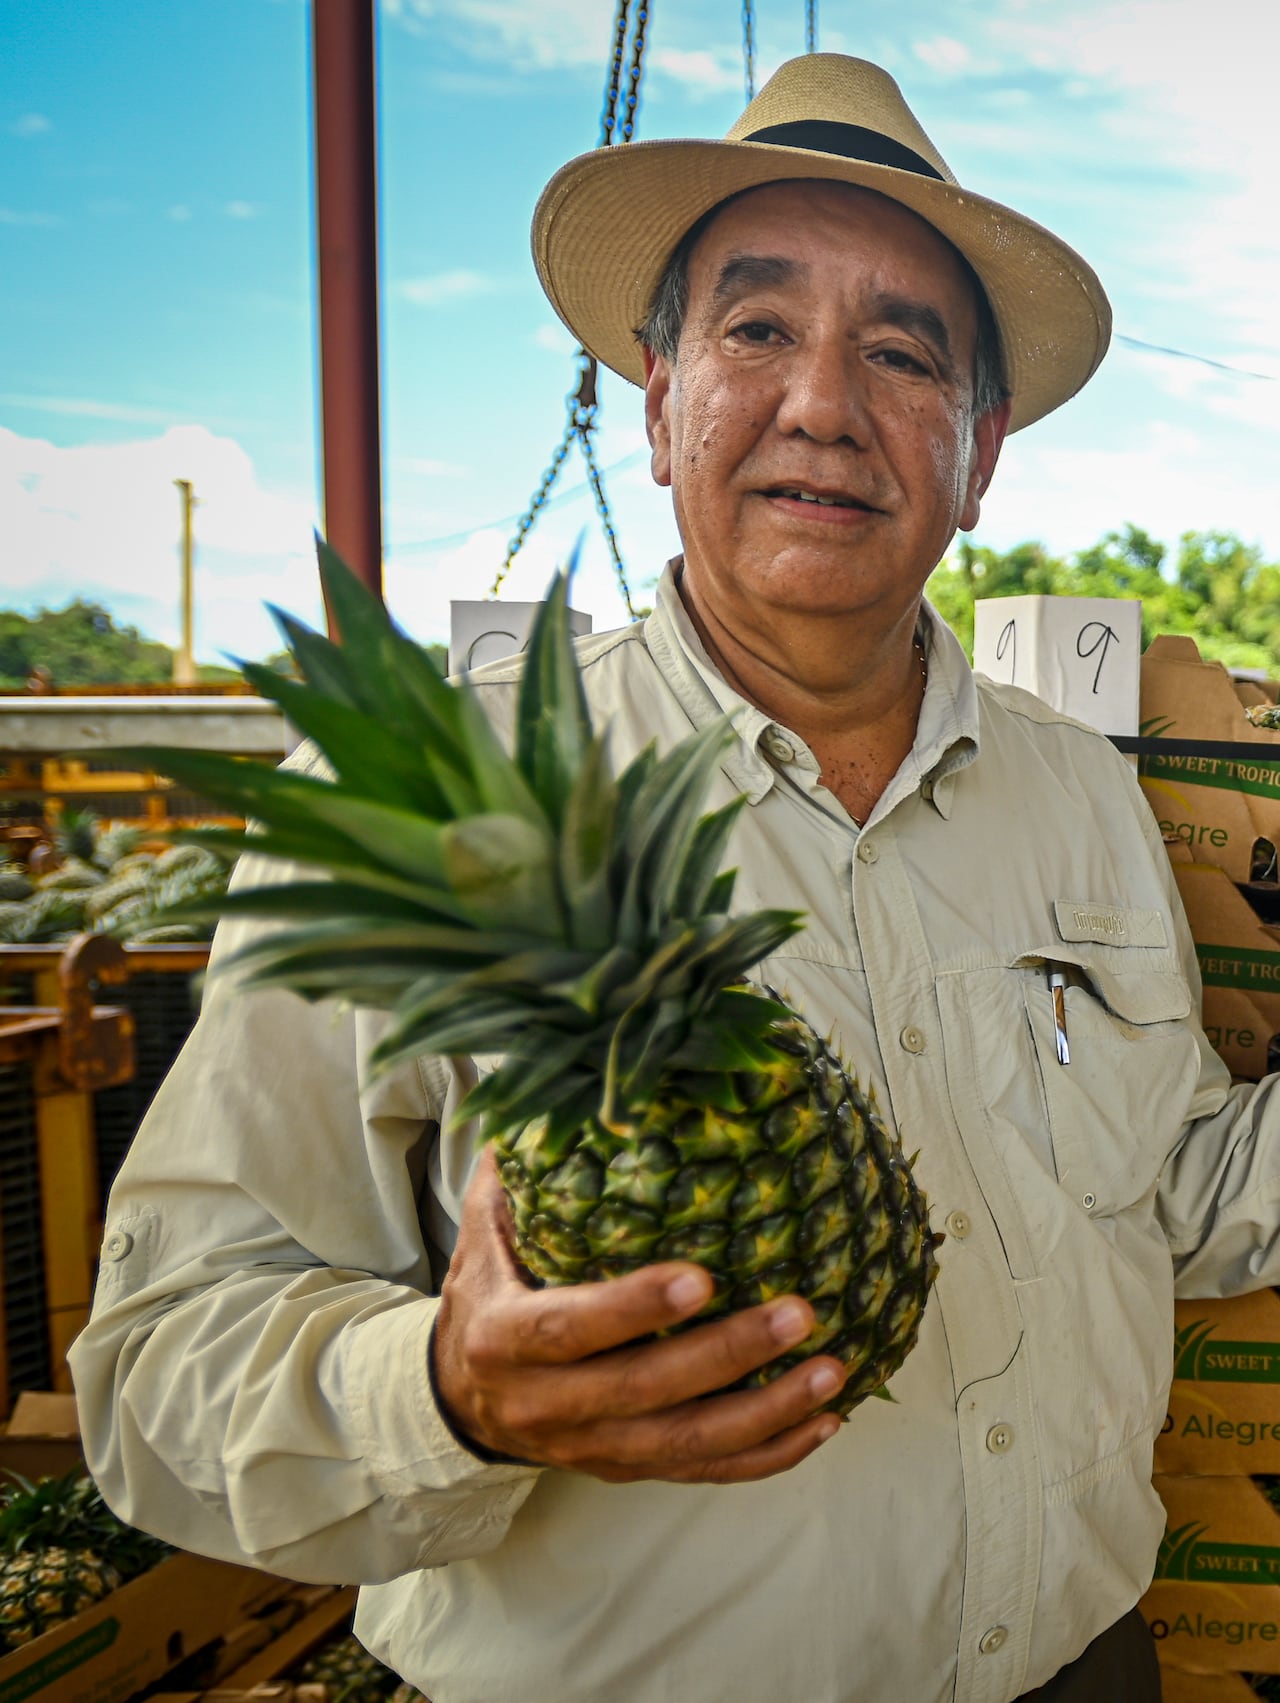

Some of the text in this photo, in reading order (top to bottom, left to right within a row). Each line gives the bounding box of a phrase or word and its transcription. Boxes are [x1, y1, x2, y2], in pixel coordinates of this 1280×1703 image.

[1077, 621, 1120, 694] 9
[1159, 820, 1228, 847] egre
[1202, 958, 1243, 976] EET
[1206, 1354, 1272, 1371] SWEET
[1195, 1555, 1259, 1571] SWEET
[1171, 1612, 1278, 1645] Alegre
